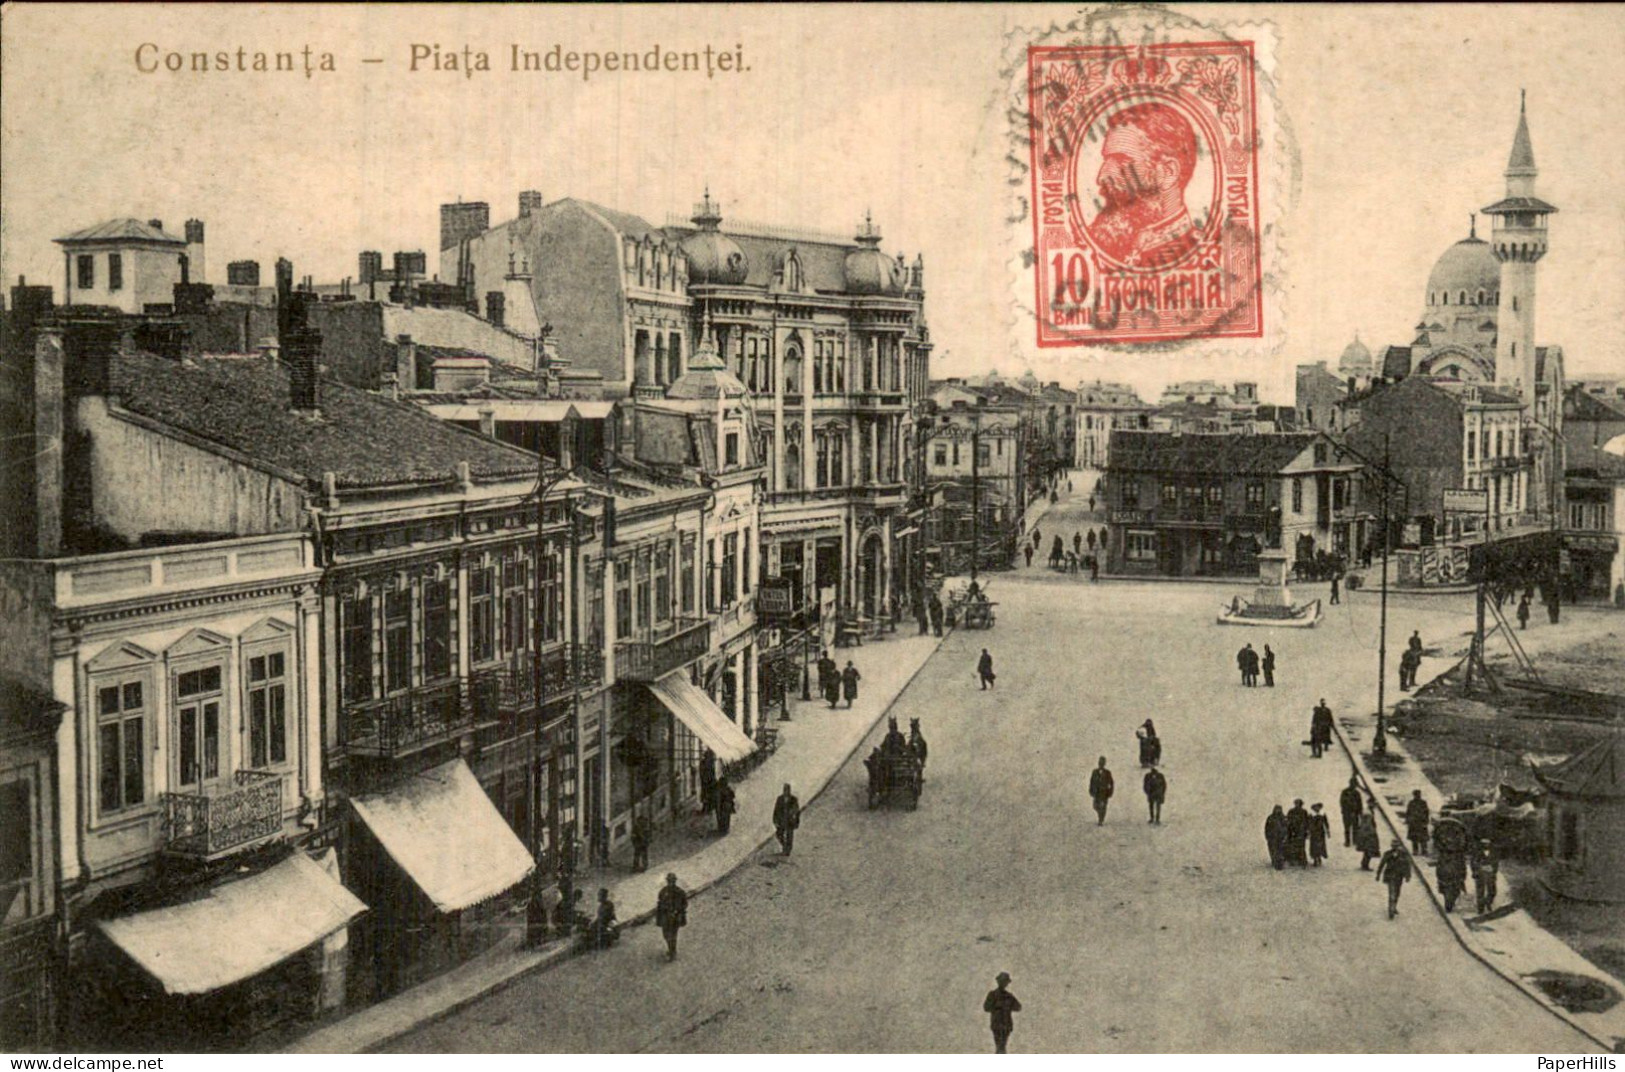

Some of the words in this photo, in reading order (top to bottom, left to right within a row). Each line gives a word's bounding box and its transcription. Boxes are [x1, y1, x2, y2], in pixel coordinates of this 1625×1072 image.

[1042, 182, 1064, 224] POSTA
[1227, 176, 1249, 218] POSTA
[1051, 252, 1090, 304] 10
[1103, 272, 1223, 312] ROMANIA
